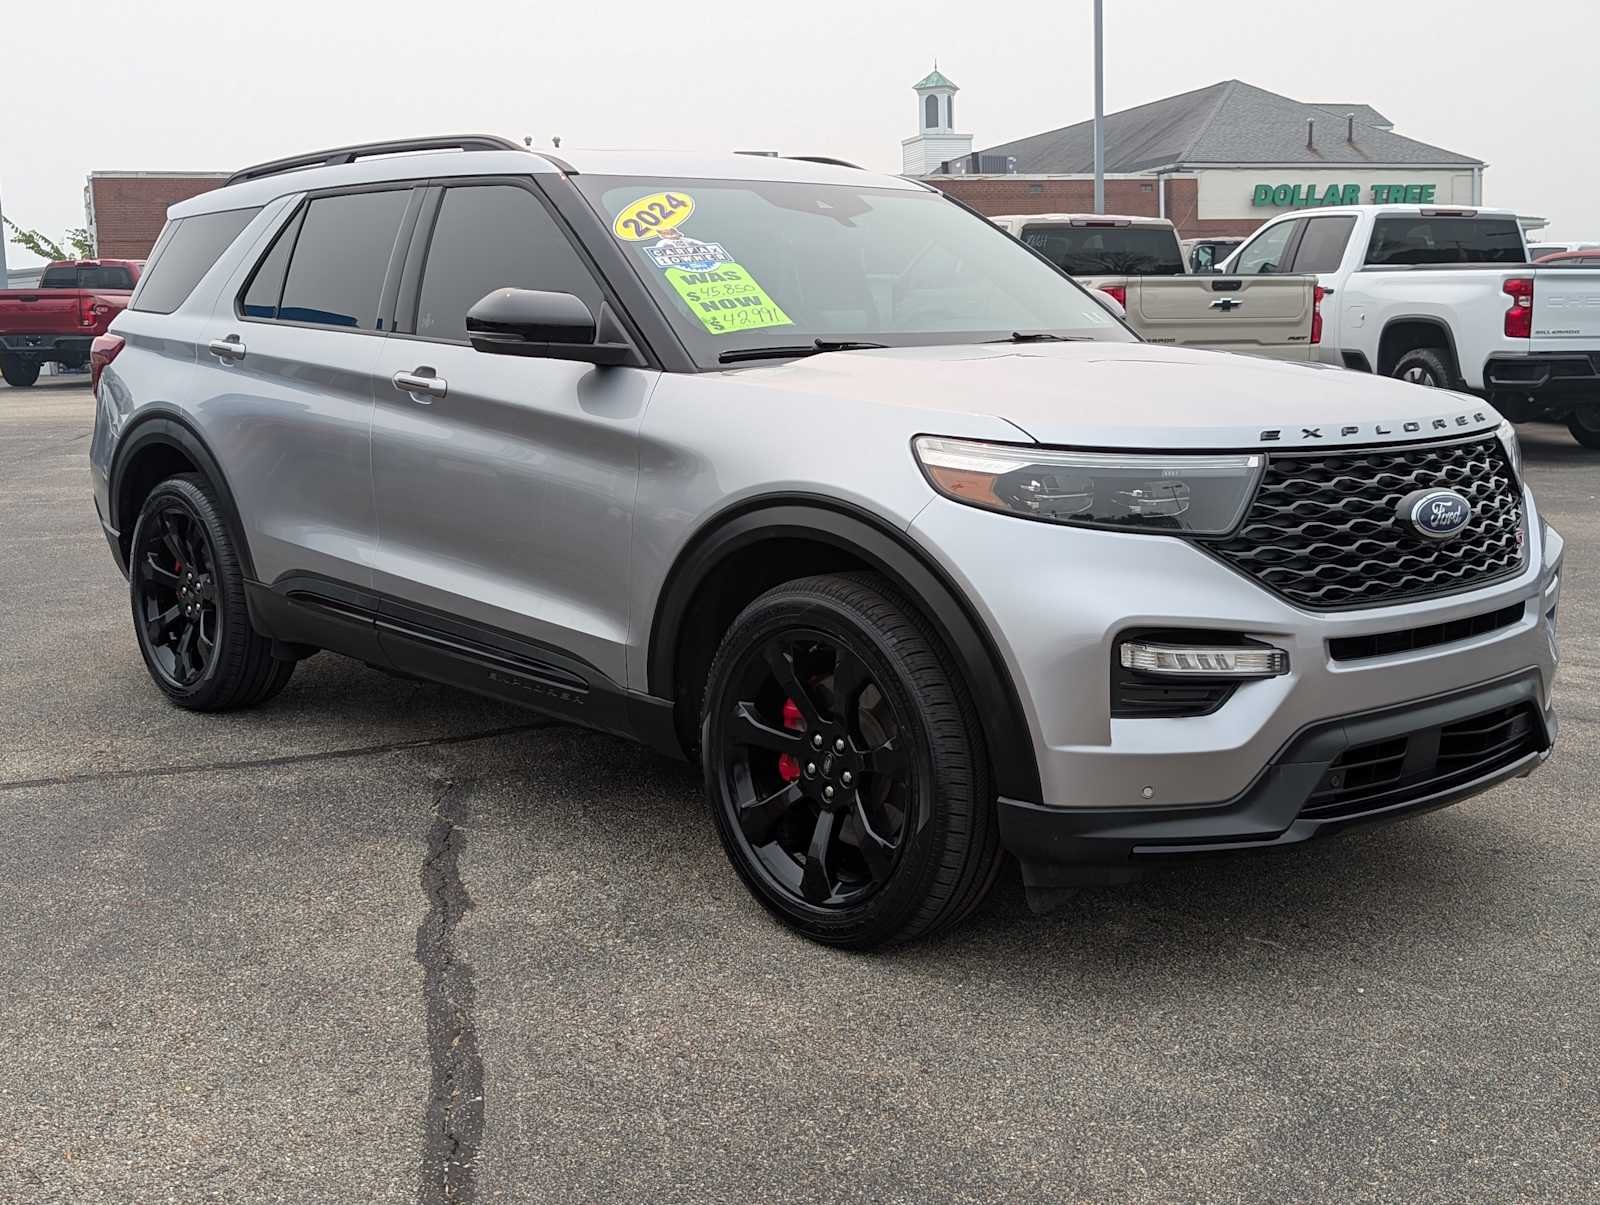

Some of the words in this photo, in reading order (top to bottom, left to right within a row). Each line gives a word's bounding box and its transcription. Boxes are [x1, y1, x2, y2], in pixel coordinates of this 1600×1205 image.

[1253, 184, 1361, 207] DOLLAR
[1371, 184, 1436, 205] TREE
[622, 193, 688, 238] 2024
[651, 246, 723, 256] CARFAX
[680, 270, 742, 286] WAS
[699, 295, 763, 313] NOW
[1260, 412, 1486, 442] EXPLORER
[1430, 501, 1462, 527] Ford
